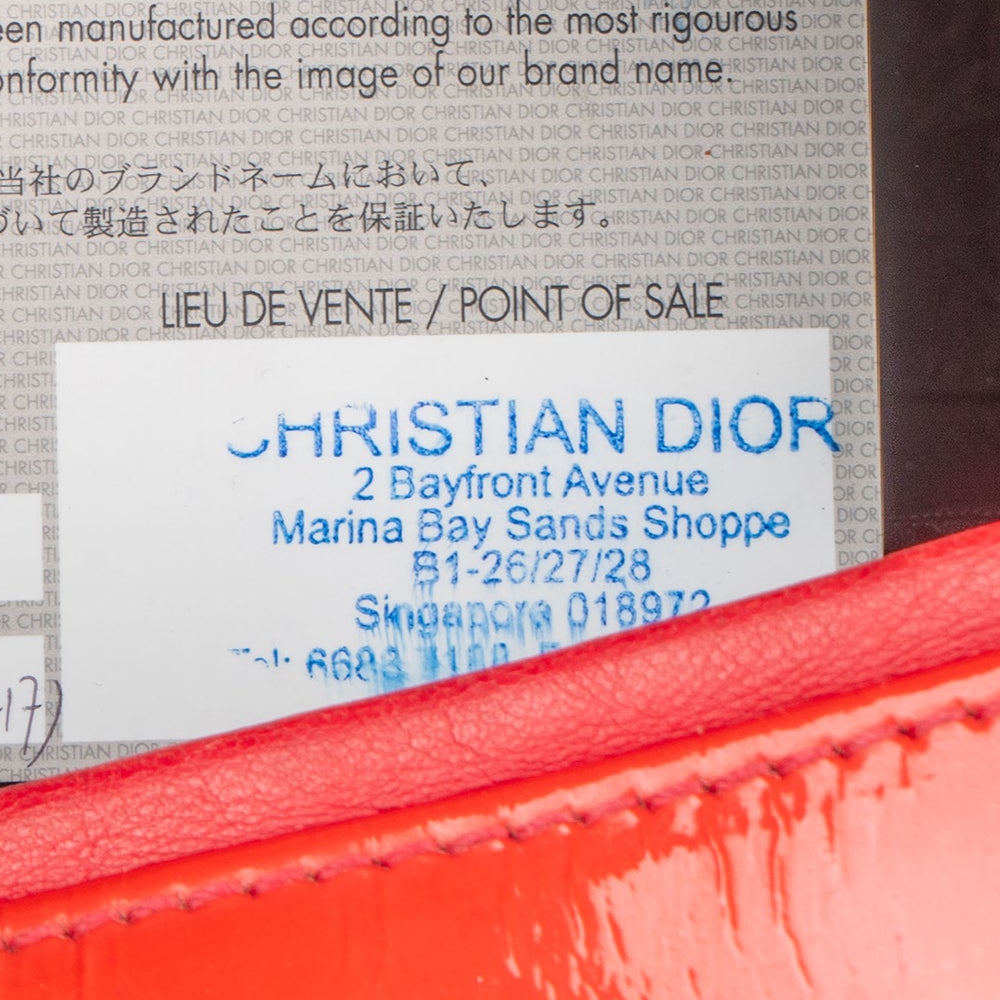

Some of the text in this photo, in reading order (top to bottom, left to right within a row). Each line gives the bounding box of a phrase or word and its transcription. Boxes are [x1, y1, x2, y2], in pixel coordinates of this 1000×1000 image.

[59, 1, 275, 42] manufactured
[290, 0, 450, 48] according
[464, 6, 493, 36] to
[567, 5, 639, 35] most
[652, 0, 798, 45] rigourous
[152, 53, 218, 91] with
[234, 53, 282, 90] the
[298, 65, 398, 99] image
[412, 49, 445, 88] of
[457, 63, 510, 87] our
[524, 47, 620, 86] brand
[635, 60, 733, 84] name.
[162, 280, 724, 330] LIEU DE VENTE / POINT OF SALE
[655, 394, 841, 456] DIOR
[353, 463, 710, 508] 2 Bayfront Avenue
[273, 503, 792, 550] Marina Bay Sands Shoppe
[412, 548, 653, 585] B1-26/27/28
